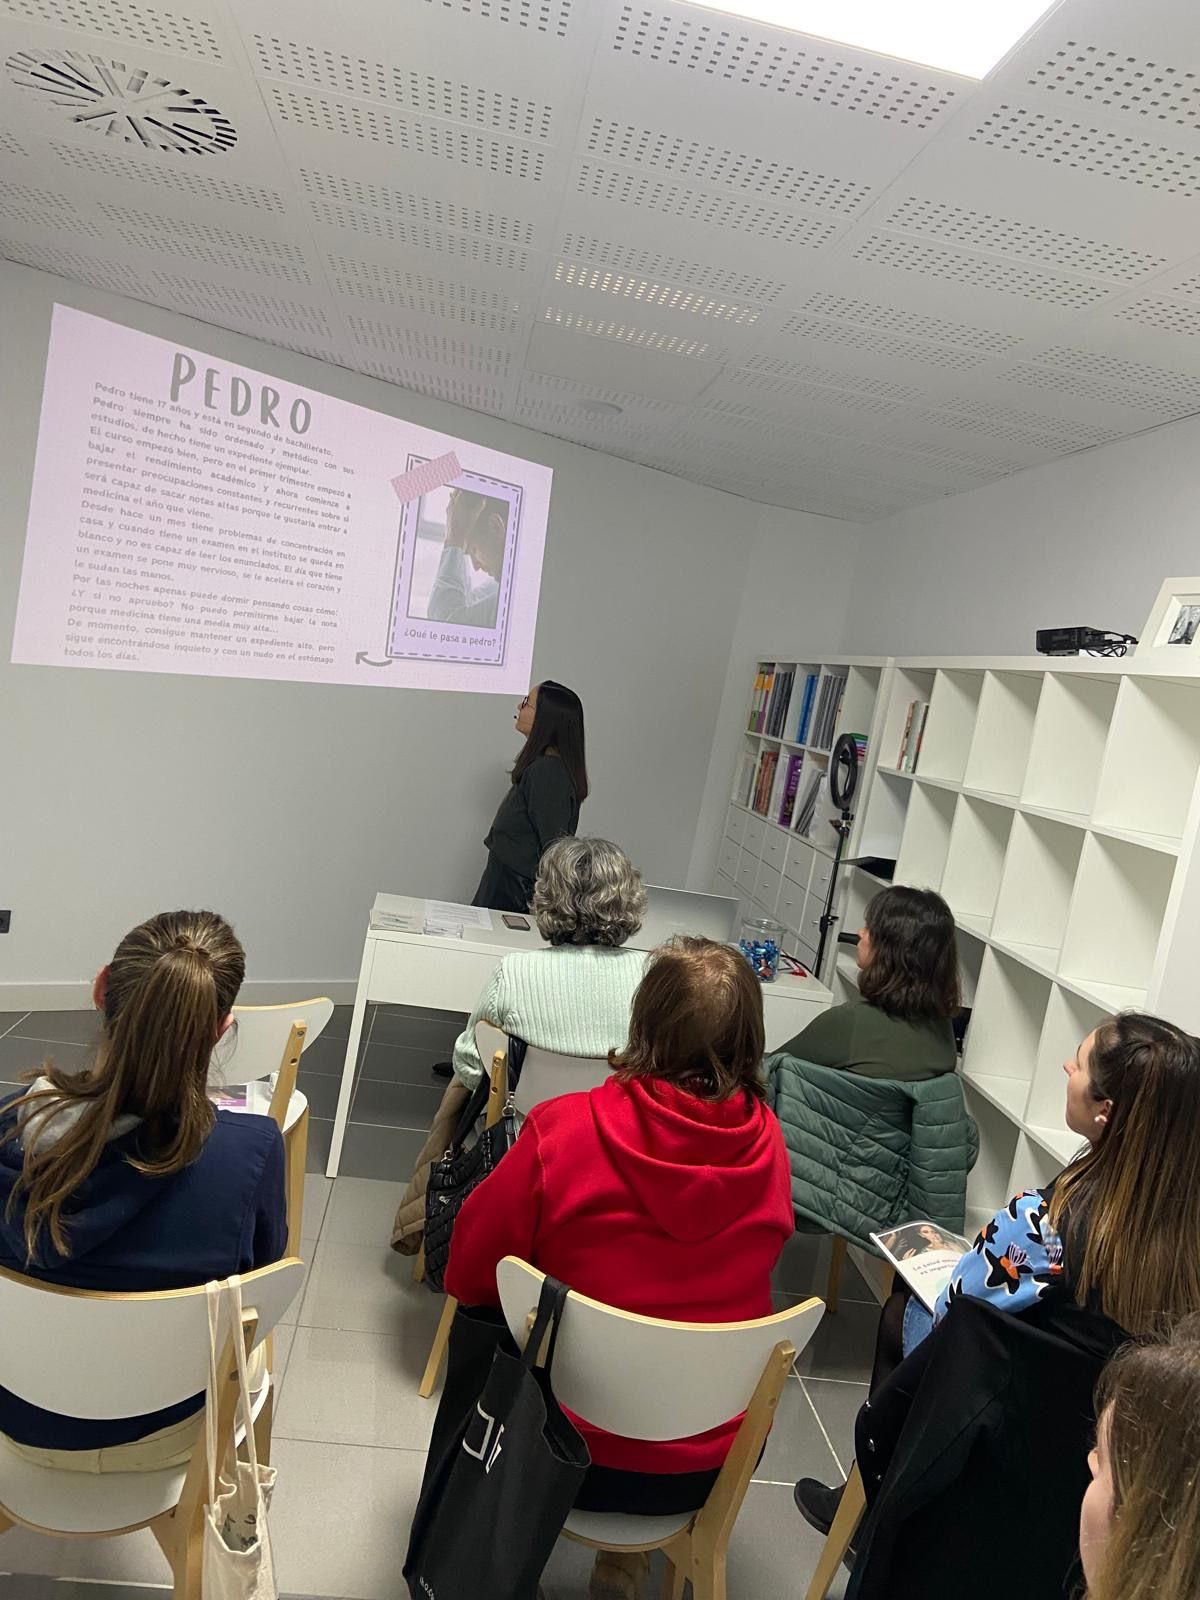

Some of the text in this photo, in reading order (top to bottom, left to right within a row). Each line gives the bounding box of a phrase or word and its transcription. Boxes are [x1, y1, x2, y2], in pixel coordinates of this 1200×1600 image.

[95, 382, 126, 397] Pedro
[130, 392, 154, 405] tiene
[158, 400, 167, 408] 17
[170, 406, 191, 416] años
[237, 425, 272, 439] segundo
[273, 434, 283, 442] de
[170, 352, 313, 435] PEDRO
[94, 397, 124, 412] Pedro
[133, 409, 171, 424] siempre
[180, 420, 192, 430] ha
[200, 427, 218, 438] sido
[225, 435, 264, 450] ordenado
[343, 467, 355, 475] sus
[142, 426, 155, 435] de
[157, 429, 186, 443] hecho
[189, 438, 212, 450] tiene
[214, 446, 226, 454] un
[228, 450, 273, 466] expediente
[88, 441, 116, 454] bajar
[126, 452, 136, 460] el
[145, 457, 202, 475] rendimiento
[276, 488, 298, 499] ahora
[305, 496, 339, 508] comienza
[90, 427, 101, 436] El
[105, 432, 134, 444] curso
[203, 457, 224, 466] pero
[249, 468, 277, 480] primer
[280, 475, 315, 490] trimestre
[83, 488, 130, 502] medicina
[133, 497, 143, 505] el
[146, 500, 164, 509] año
[166, 505, 184, 513] que
[87, 458, 341, 520] presentar preocupaciones constantes recurrentes sobre
[111, 479, 141, 490] capaz
[145, 485, 157, 494] de
[161, 490, 186, 500] sacar
[189, 496, 215, 506] notas
[217, 502, 239, 512] altas
[242, 508, 271, 518] porque
[318, 524, 341, 532] entrar
[82, 501, 114, 513] Desde
[120, 508, 144, 519] hace
[149, 514, 162, 523] un
[167, 519, 186, 527] mes
[192, 521, 214, 533] tiene
[219, 529, 263, 542] problemas
[79, 530, 114, 543] blanco
[155, 545, 182, 555] capaz
[185, 549, 196, 557] de
[199, 551, 217, 560] leer
[220, 554, 232, 563] los
[325, 572, 343, 581] tiene
[80, 517, 104, 526] casa
[118, 524, 155, 536] cuando
[160, 530, 183, 541] tiene
[187, 536, 198, 544] un
[202, 539, 235, 550] examen
[263, 548, 297, 561] instituto
[310, 559, 333, 567] queda
[75, 560, 85, 568] le
[89, 564, 120, 573] sudan
[123, 567, 138, 576] las
[94, 550, 134, 561] examen
[151, 559, 174, 568] pone
[178, 563, 197, 572] muy
[265, 577, 294, 586] acelera
[73, 574, 92, 583] Por
[96, 577, 111, 586] las
[116, 582, 150, 591] noches
[154, 587, 187, 596] apenas
[190, 592, 218, 600] puede
[221, 595, 250, 604] dormir
[253, 600, 290, 610] pensando
[68, 618, 82, 627] De
[145, 627, 186, 638] consigue
[191, 632, 233, 642] mantener
[251, 639, 294, 648] expediente
[69, 605, 107, 615] porque
[110, 610, 155, 620] medicina
[159, 613, 182, 623] tiene
[204, 620, 230, 628] media
[181, 603, 195, 611] No
[201, 607, 228, 615] puedo
[233, 611, 279, 621] permitirme
[284, 615, 304, 624] bajar
[65, 648, 94, 657] todos
[98, 651, 113, 659] los
[66, 633, 94, 644] sigue
[174, 642, 211, 653] inquieto
[404, 628, 497, 648] ¿Qué le pasa a pedro?
